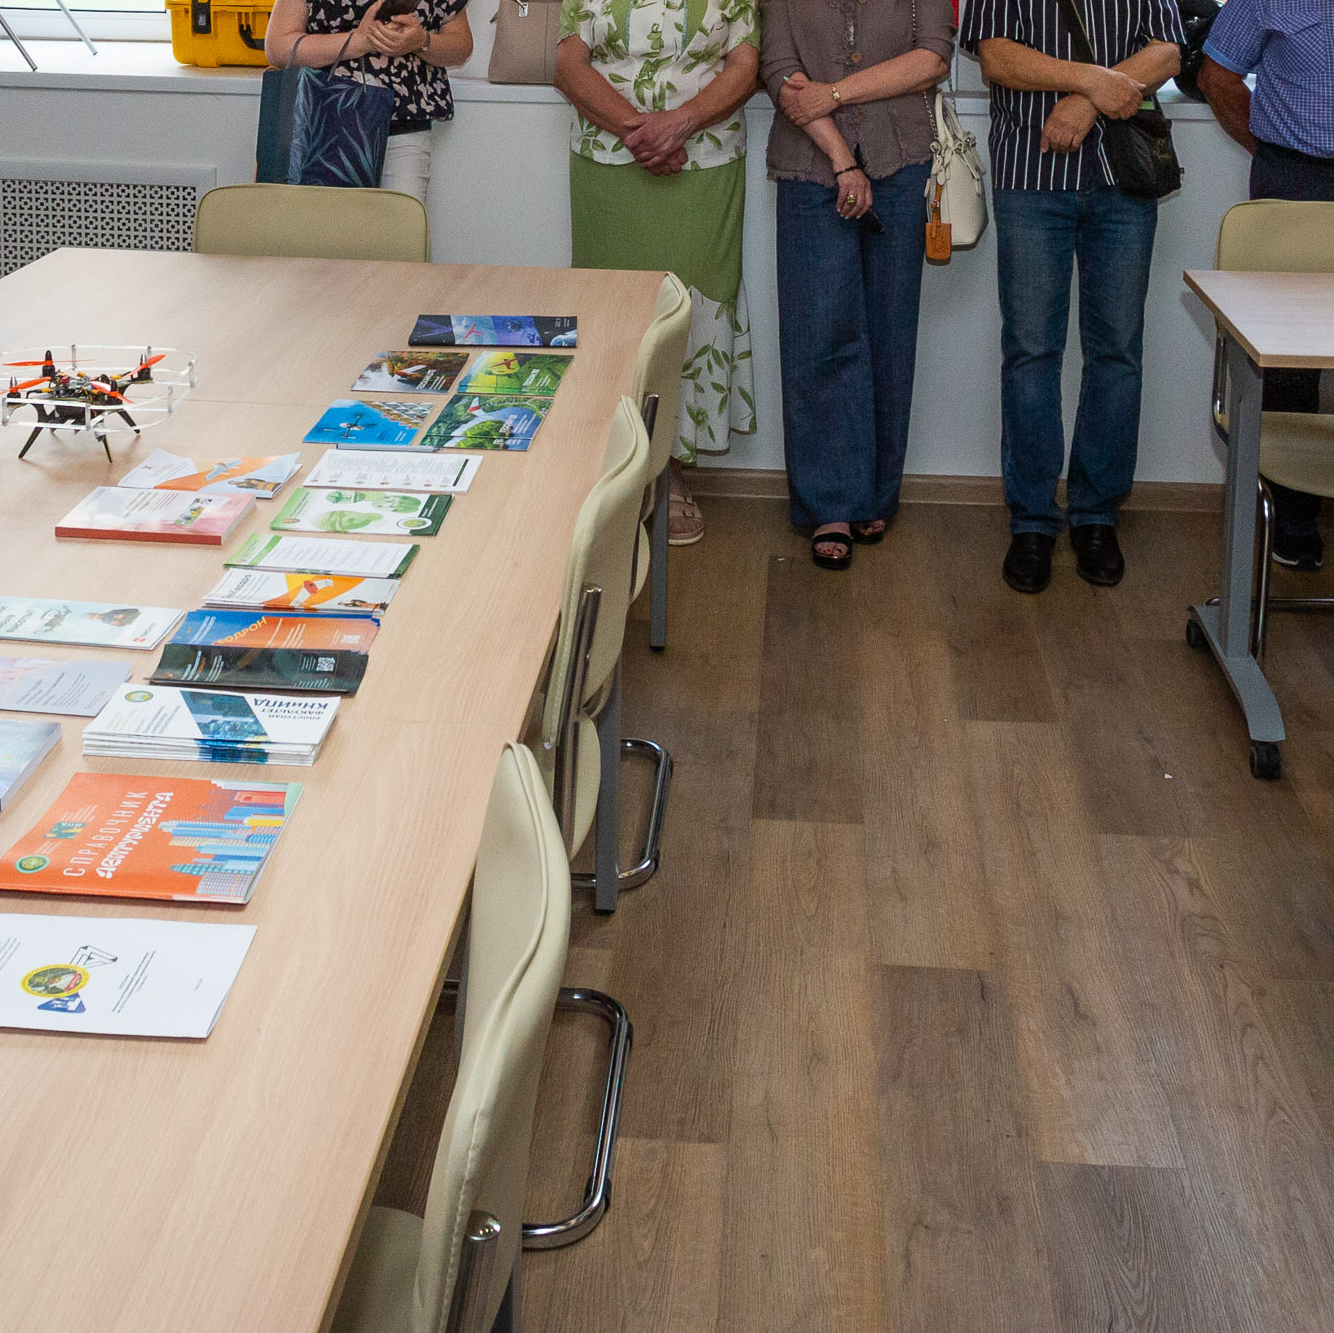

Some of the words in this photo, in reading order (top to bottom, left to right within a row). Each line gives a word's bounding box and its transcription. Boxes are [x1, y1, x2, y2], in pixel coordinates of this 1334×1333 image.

[260, 708, 324, 716] ФАКУЛЬТЕТ
[62, 790, 148, 877] СПРАВОЧНИК
[95, 791, 175, 879] АБИТУРИЕНТА
